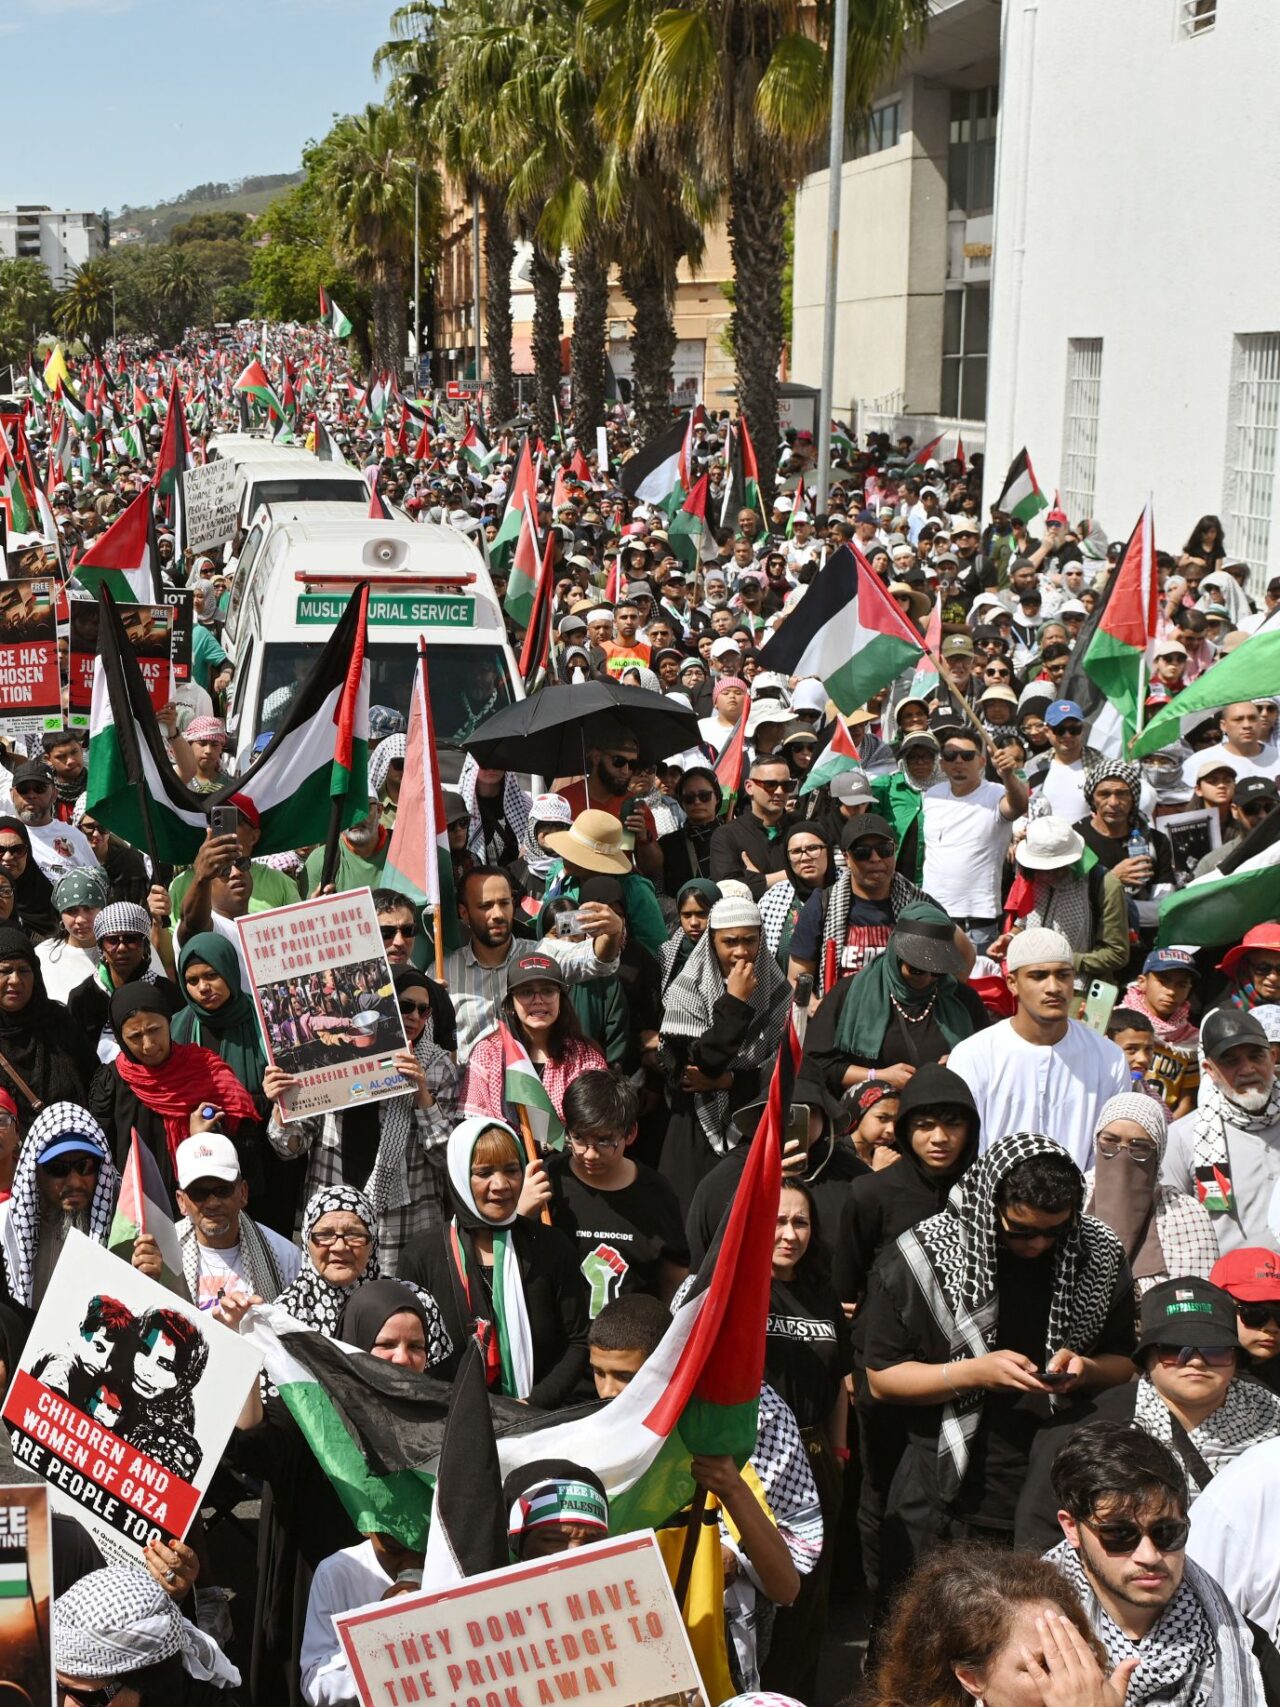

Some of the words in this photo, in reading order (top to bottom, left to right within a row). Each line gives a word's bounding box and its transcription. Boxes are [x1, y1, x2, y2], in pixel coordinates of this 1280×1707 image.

[30, 582, 50, 591] FREE
[151, 608, 168, 617] FREE
[368, 603, 408, 620] URIAL
[411, 604, 468, 621] SERVICE
[21, 648, 48, 666] HAS
[139, 662, 160, 678] AS
[255, 925, 285, 944] THEY
[290, 914, 327, 937] DON'T
[332, 906, 364, 925] HAVE
[254, 942, 276, 961] THE
[281, 926, 353, 955] PRIVILEDGE
[356, 920, 372, 937] TO
[281, 954, 313, 972] LOOK
[318, 943, 354, 963] AWAY
[352, 1060, 375, 1076] NOW
[593, 1231, 634, 1241] GENOCIDE
[37, 1392, 126, 1465] CHILDREN
[128, 1457, 170, 1494] AND
[22, 1407, 90, 1469] WOMEN
[92, 1459, 119, 1486] OF
[120, 1478, 168, 1524] GAZA
[46, 1454, 120, 1521] PEOPLE
[122, 1510, 162, 1548] TOO
[558, 1485, 588, 1497] FREE
[384, 1628, 453, 1669] THEY
[465, 1602, 553, 1648] DON'T
[565, 1578, 641, 1622] HAVE
[383, 1670, 436, 1707] THE
[446, 1623, 617, 1693] PRIVILEDGE
[627, 1611, 665, 1643] TO
[536, 1660, 618, 1705] AWAY
